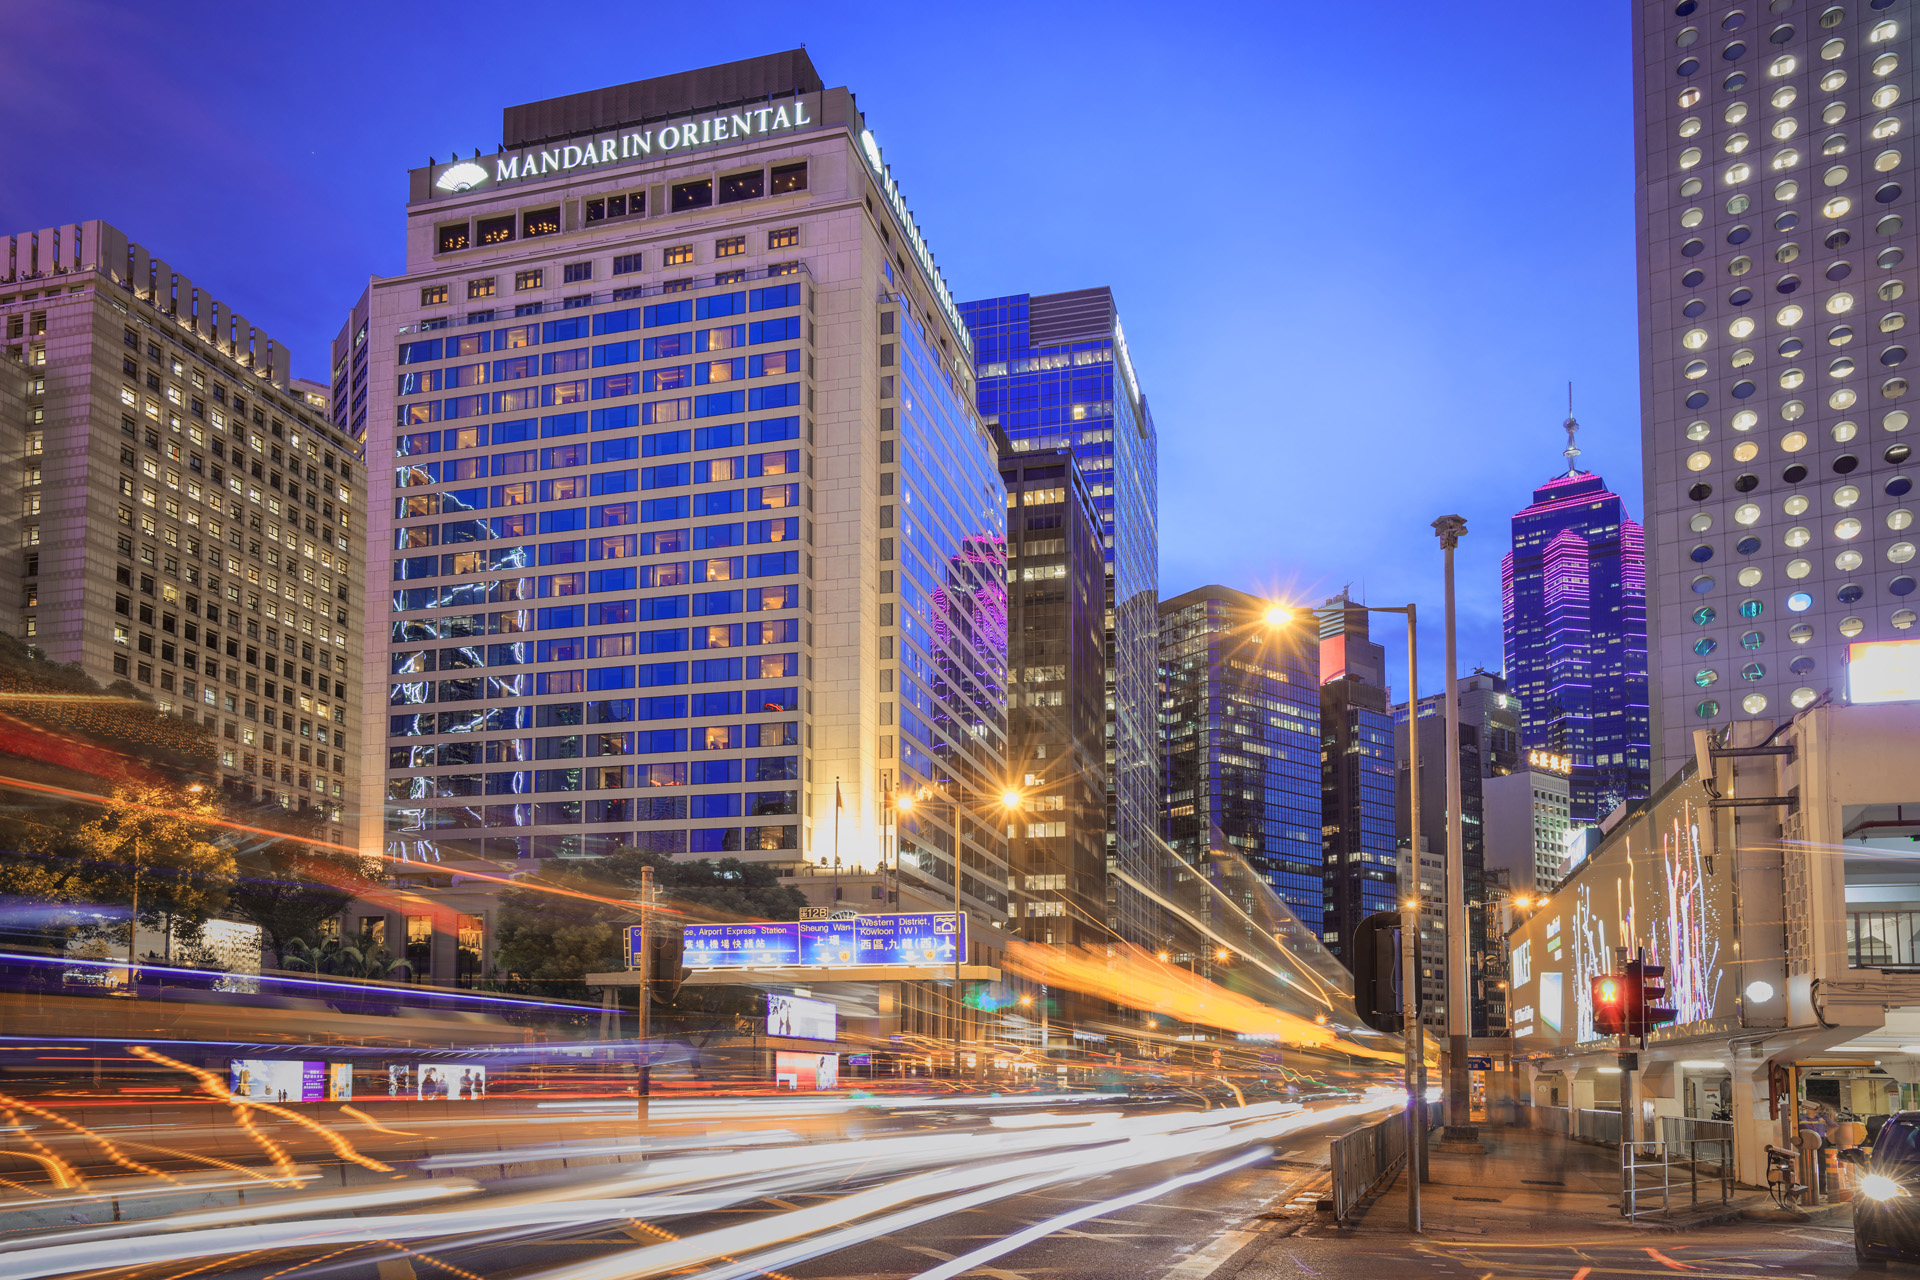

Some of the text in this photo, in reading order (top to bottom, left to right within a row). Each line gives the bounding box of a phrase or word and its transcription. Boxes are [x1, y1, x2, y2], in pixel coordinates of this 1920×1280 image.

[495, 101, 811, 182] MANDARIN ORIENTAL
[883, 168, 971, 355] MANDARIN ORIENTAL
[860, 919, 894, 927] Western
[699, 927, 722, 936] Airport
[726, 927, 756, 936] Express
[761, 926, 787, 934] Station
[800, 924, 829, 933] Sheung
[860, 927, 894, 936] Kowloon
